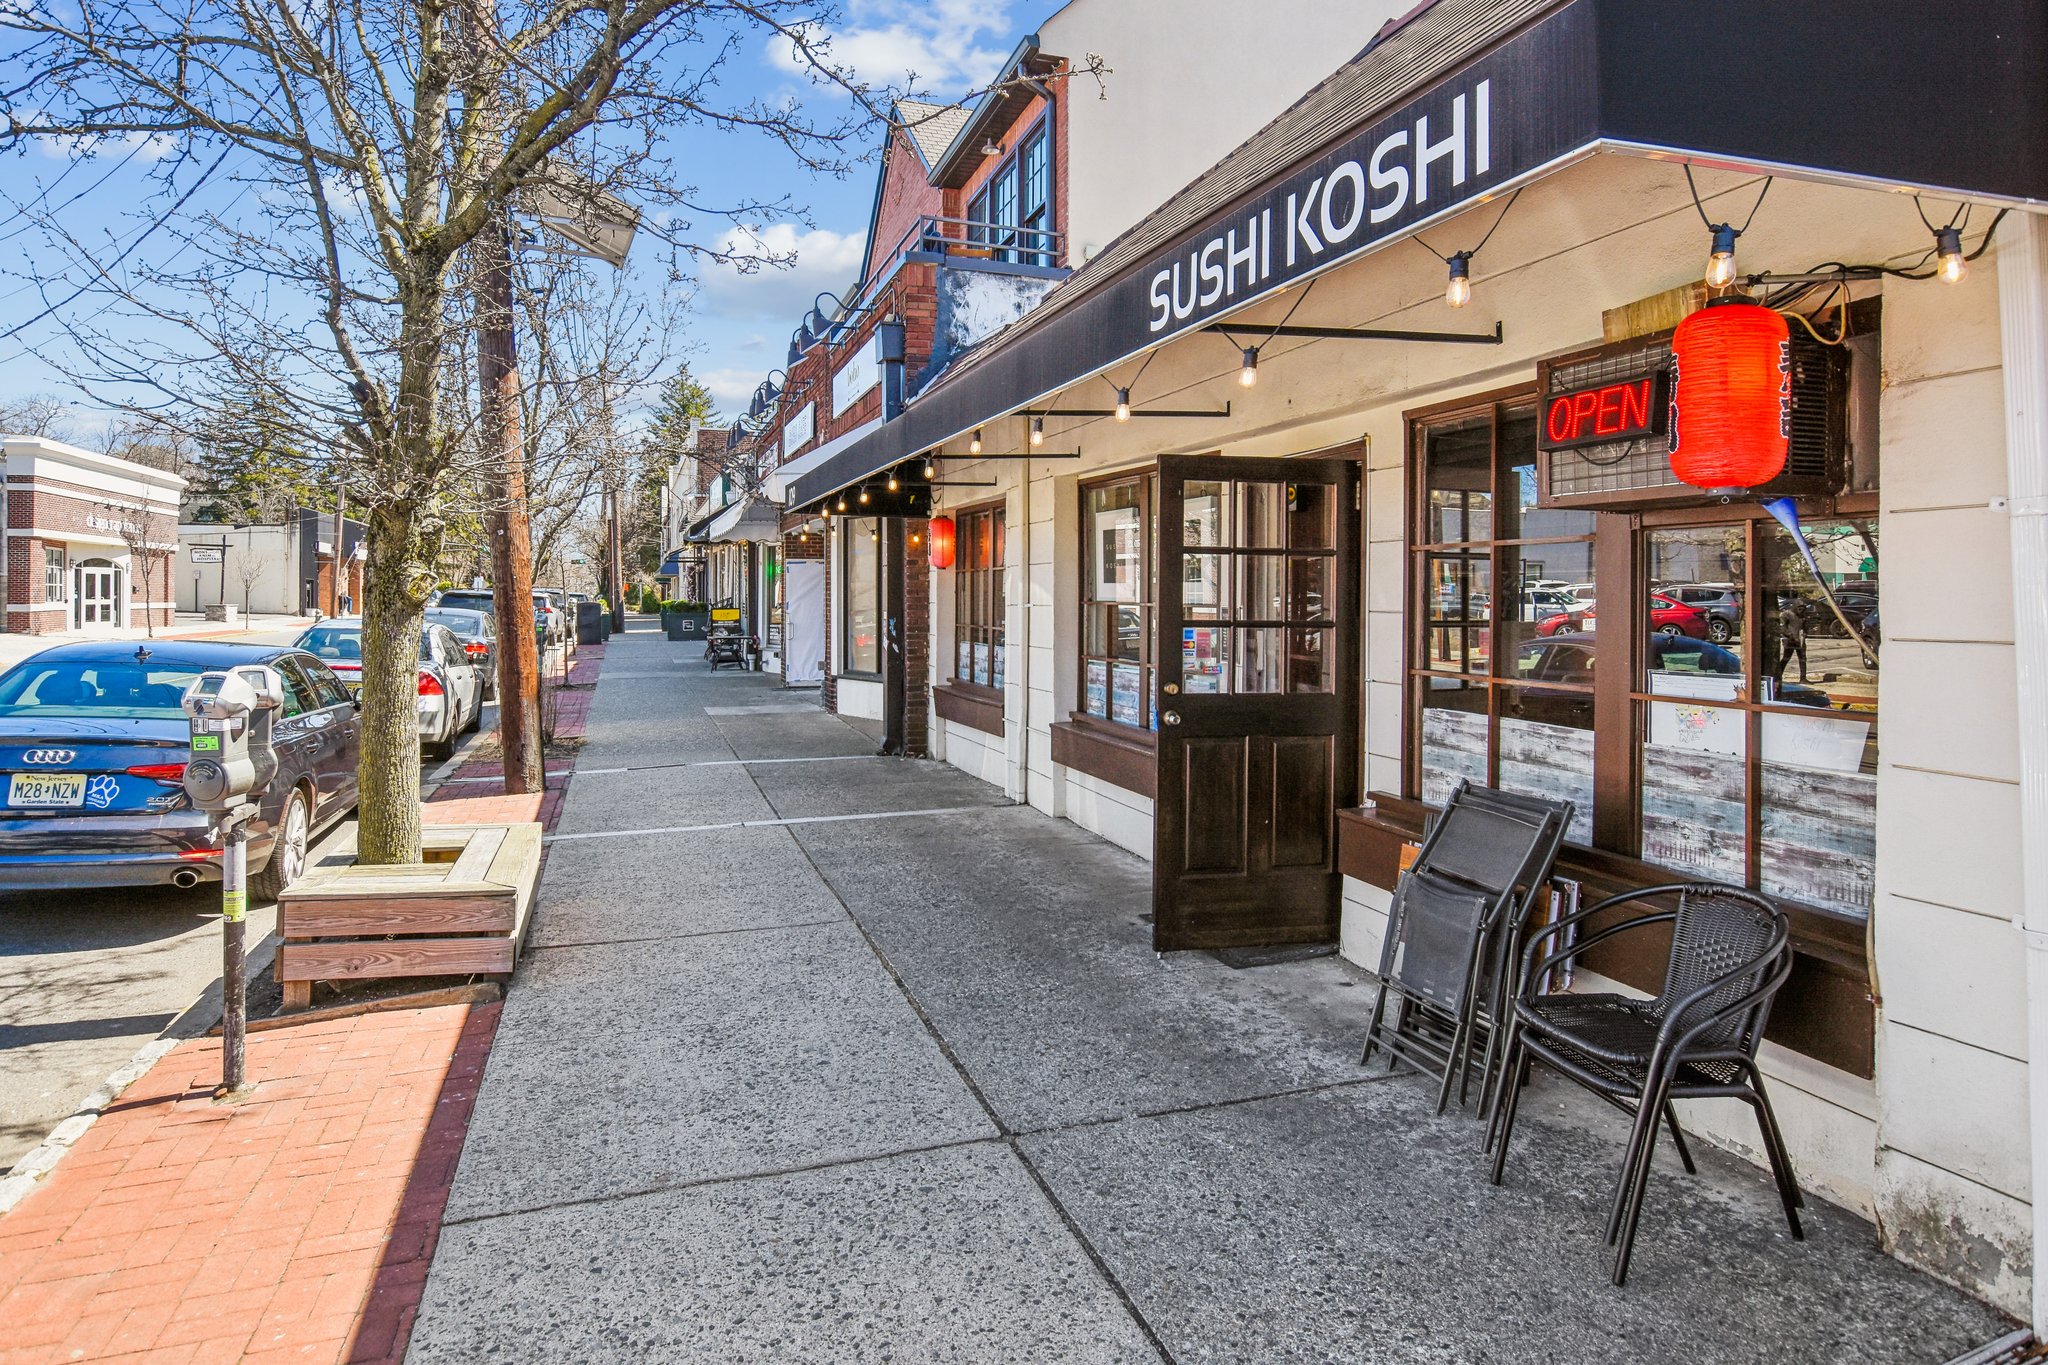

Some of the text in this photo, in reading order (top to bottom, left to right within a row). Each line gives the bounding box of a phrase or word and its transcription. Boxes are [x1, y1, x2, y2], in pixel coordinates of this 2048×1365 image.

[1150, 79, 1490, 332] SUSHI KOSHI
[1548, 380, 1652, 442] OPEN
[14, 783, 80, 798] M28 NZW
[47, 775, 67, 783] Jersey
